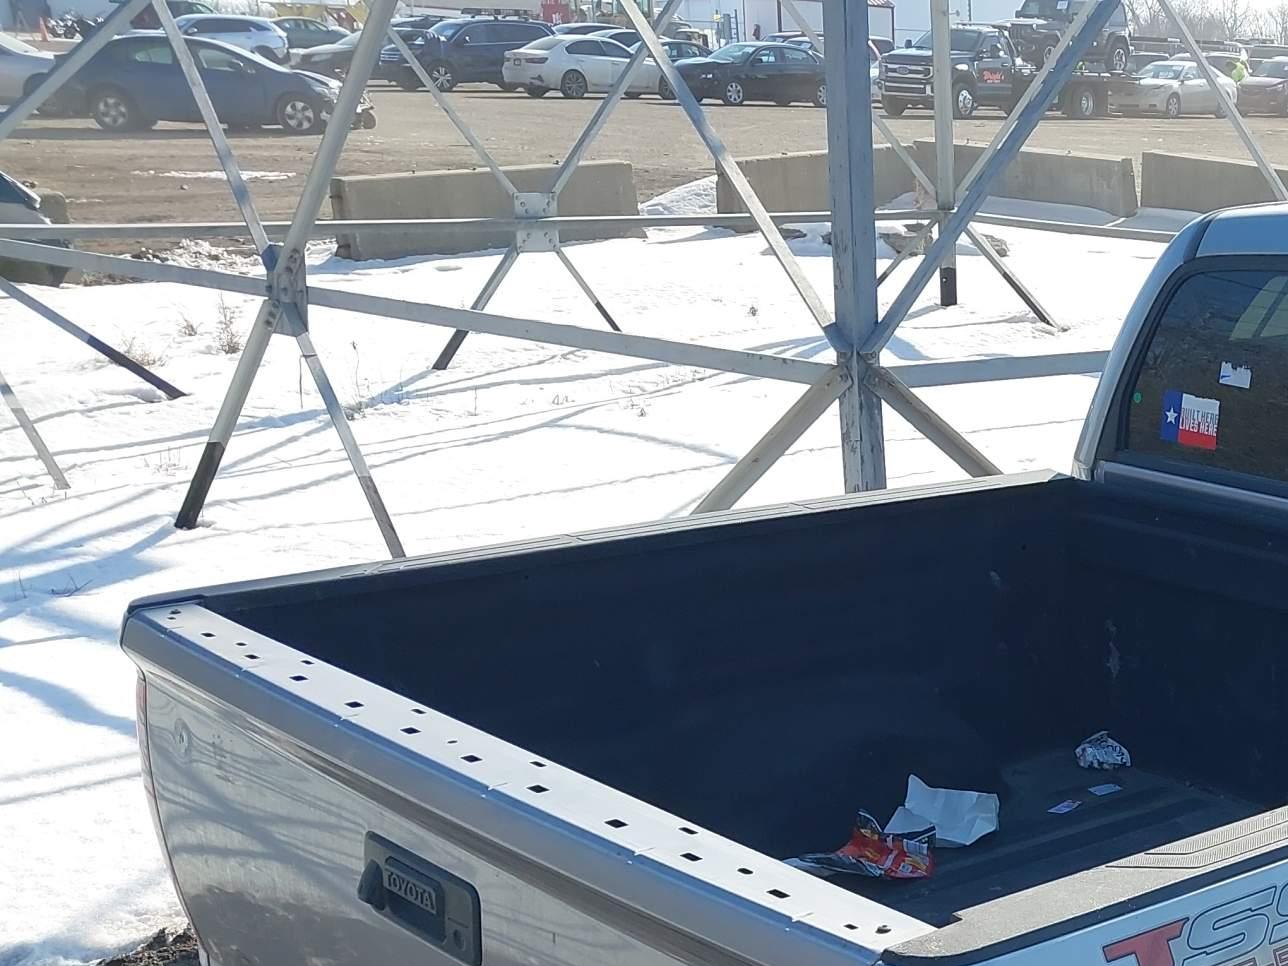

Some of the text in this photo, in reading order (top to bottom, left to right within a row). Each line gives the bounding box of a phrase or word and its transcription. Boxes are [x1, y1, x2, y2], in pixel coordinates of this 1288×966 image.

[1179, 416, 1218, 436] LIVES HERE
[1181, 407, 1218, 425] BUILT HERE
[383, 871, 437, 913] TOYOTA
